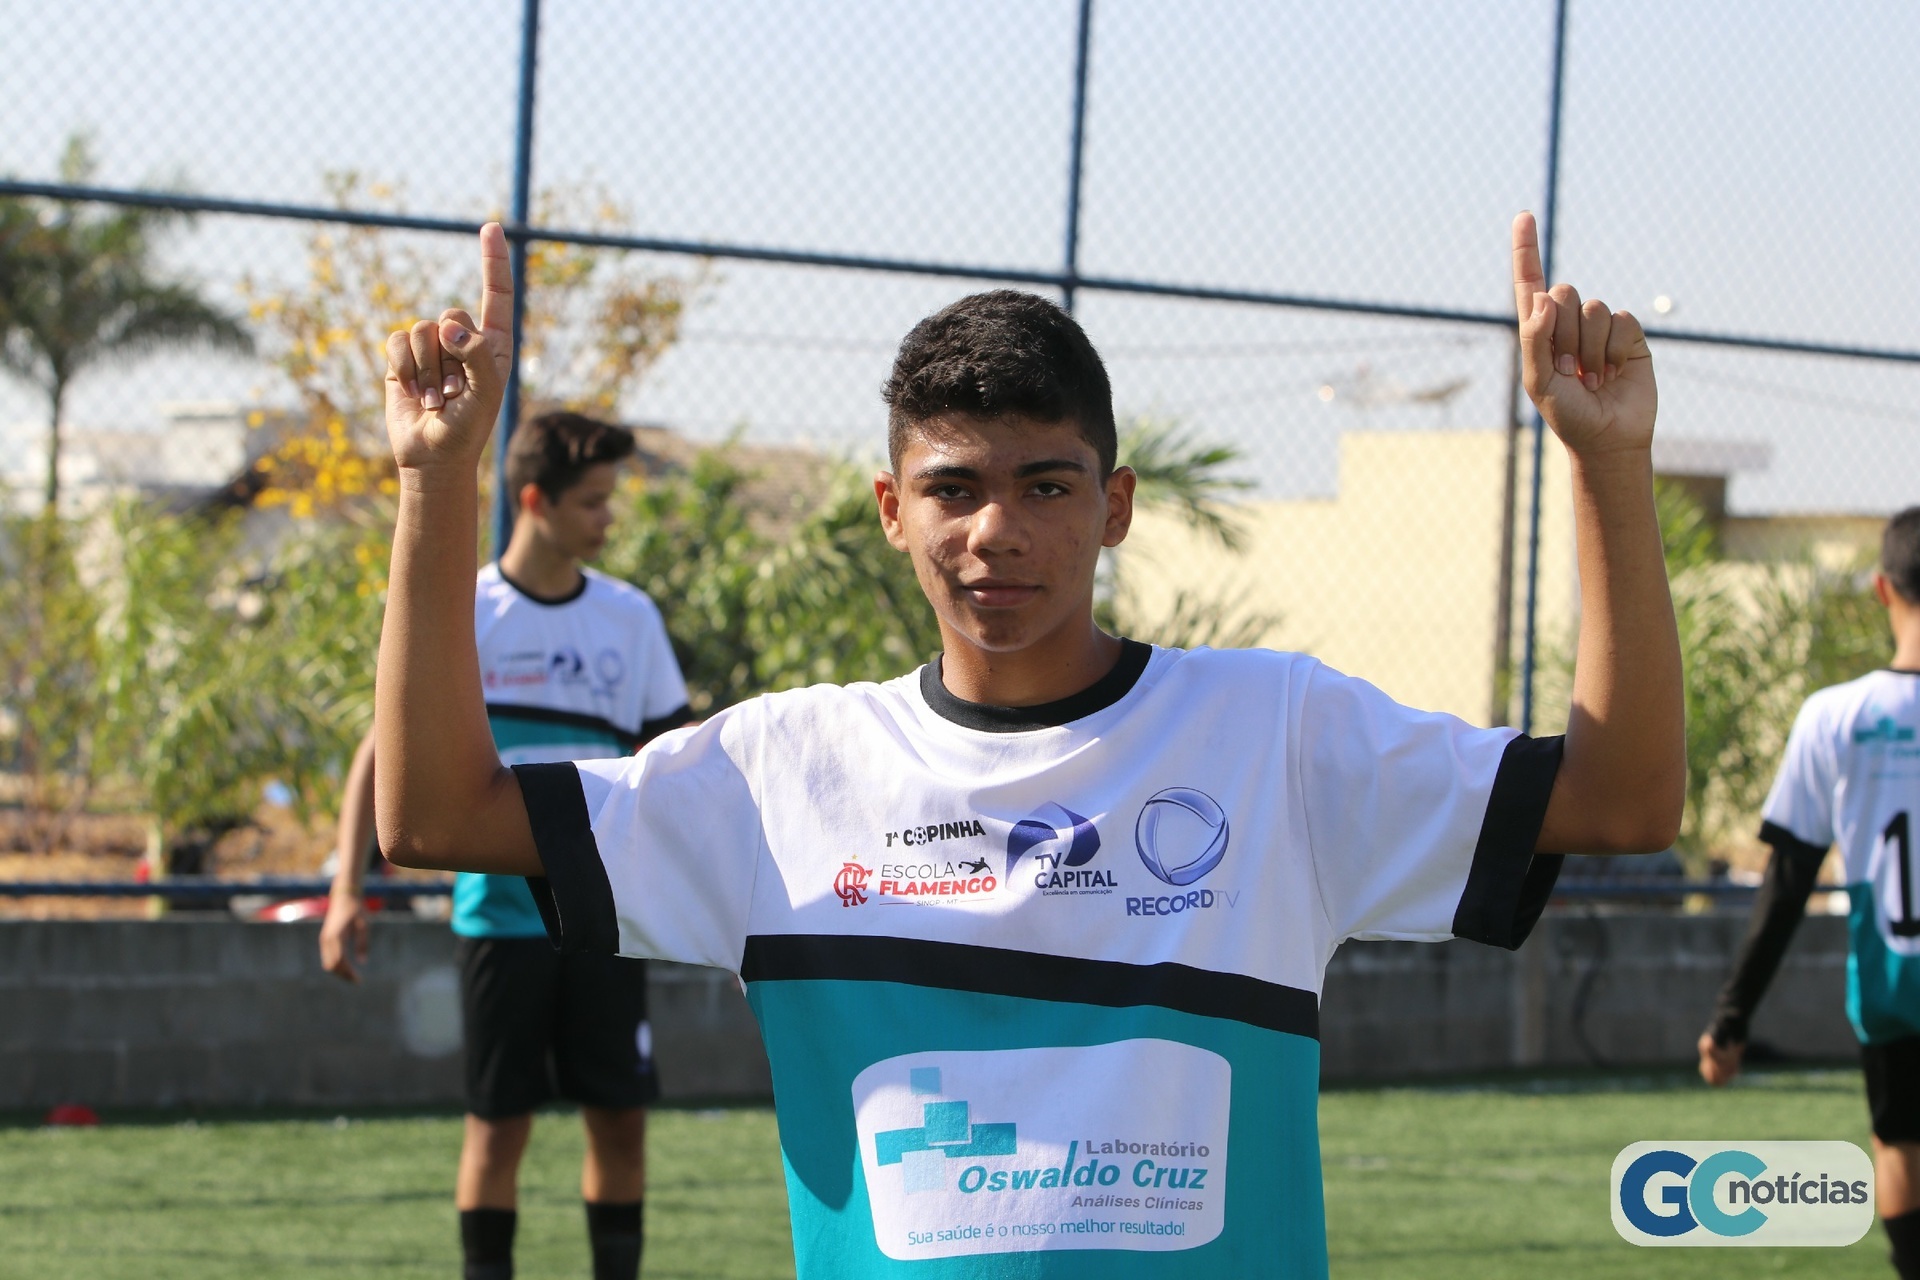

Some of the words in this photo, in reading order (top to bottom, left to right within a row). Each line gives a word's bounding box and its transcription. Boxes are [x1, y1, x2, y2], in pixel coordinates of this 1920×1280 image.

[903, 820, 986, 846] COPINHA
[881, 862, 956, 879] ESCOLA
[1034, 852, 1062, 869] TV
[879, 876, 997, 896] FLAMENGO
[1034, 870, 1118, 889] CAPITAL
[1086, 1138, 1210, 1158] Laboratório
[958, 1140, 1120, 1194] Oswaldo
[1132, 1159, 1208, 1190] Cruz
[1071, 1195, 1140, 1208] Análises
[1144, 1196, 1204, 1211] Clínicas
[908, 1231, 934, 1246] Sua
[937, 1223, 982, 1243] saúde
[985, 1222, 994, 1238] é
[999, 1225, 1008, 1237] o
[1012, 1222, 1056, 1237] nosso
[1060, 1218, 1116, 1234] melhor
[1120, 1220, 1186, 1236] resultado!
